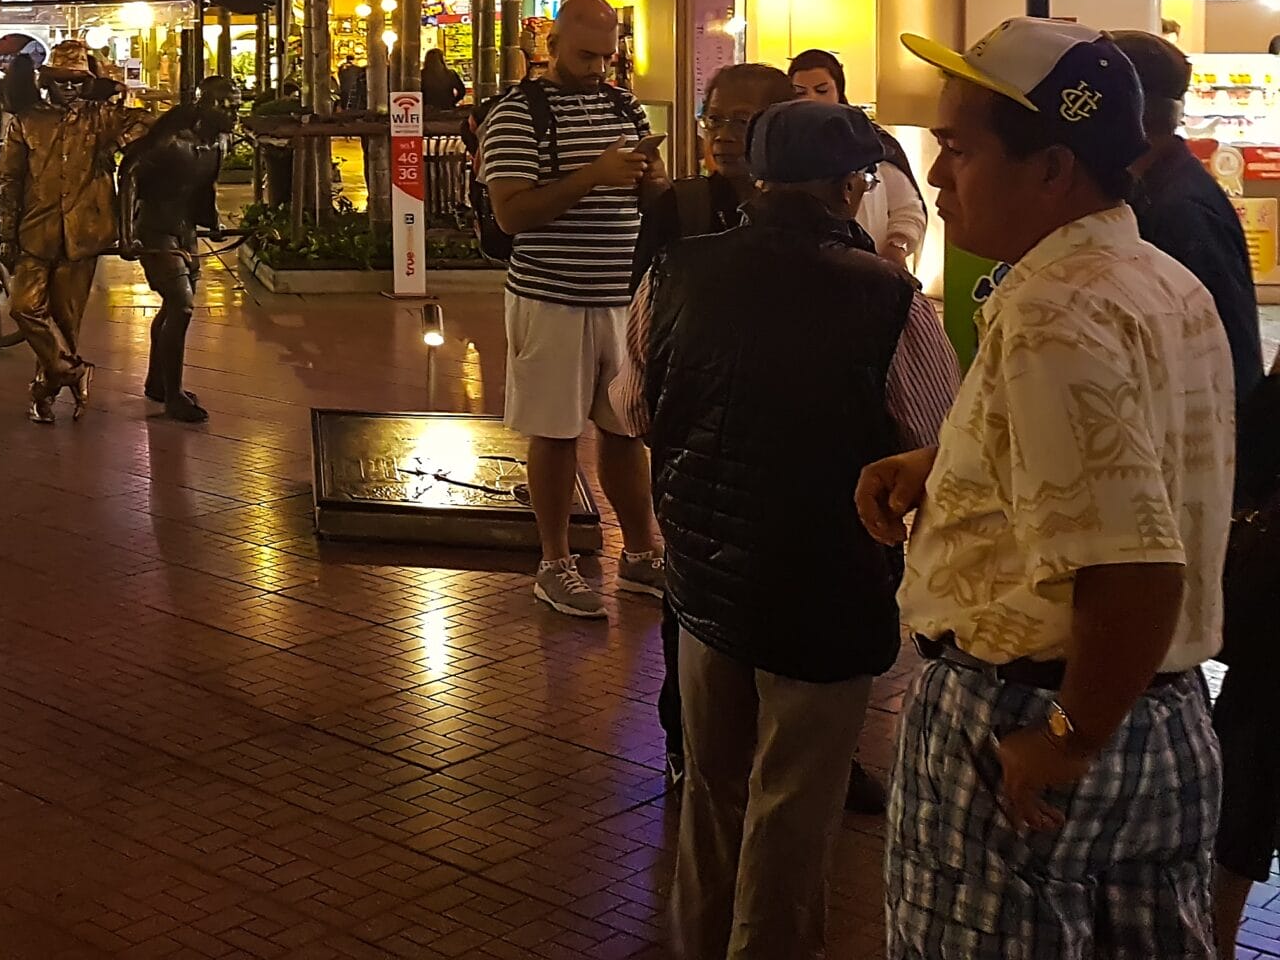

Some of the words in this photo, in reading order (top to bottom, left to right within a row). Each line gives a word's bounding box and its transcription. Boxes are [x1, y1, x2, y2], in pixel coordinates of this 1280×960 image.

[398, 153, 418, 164] 4G
[398, 168, 417, 180] 3G
[406, 251, 415, 276] true
